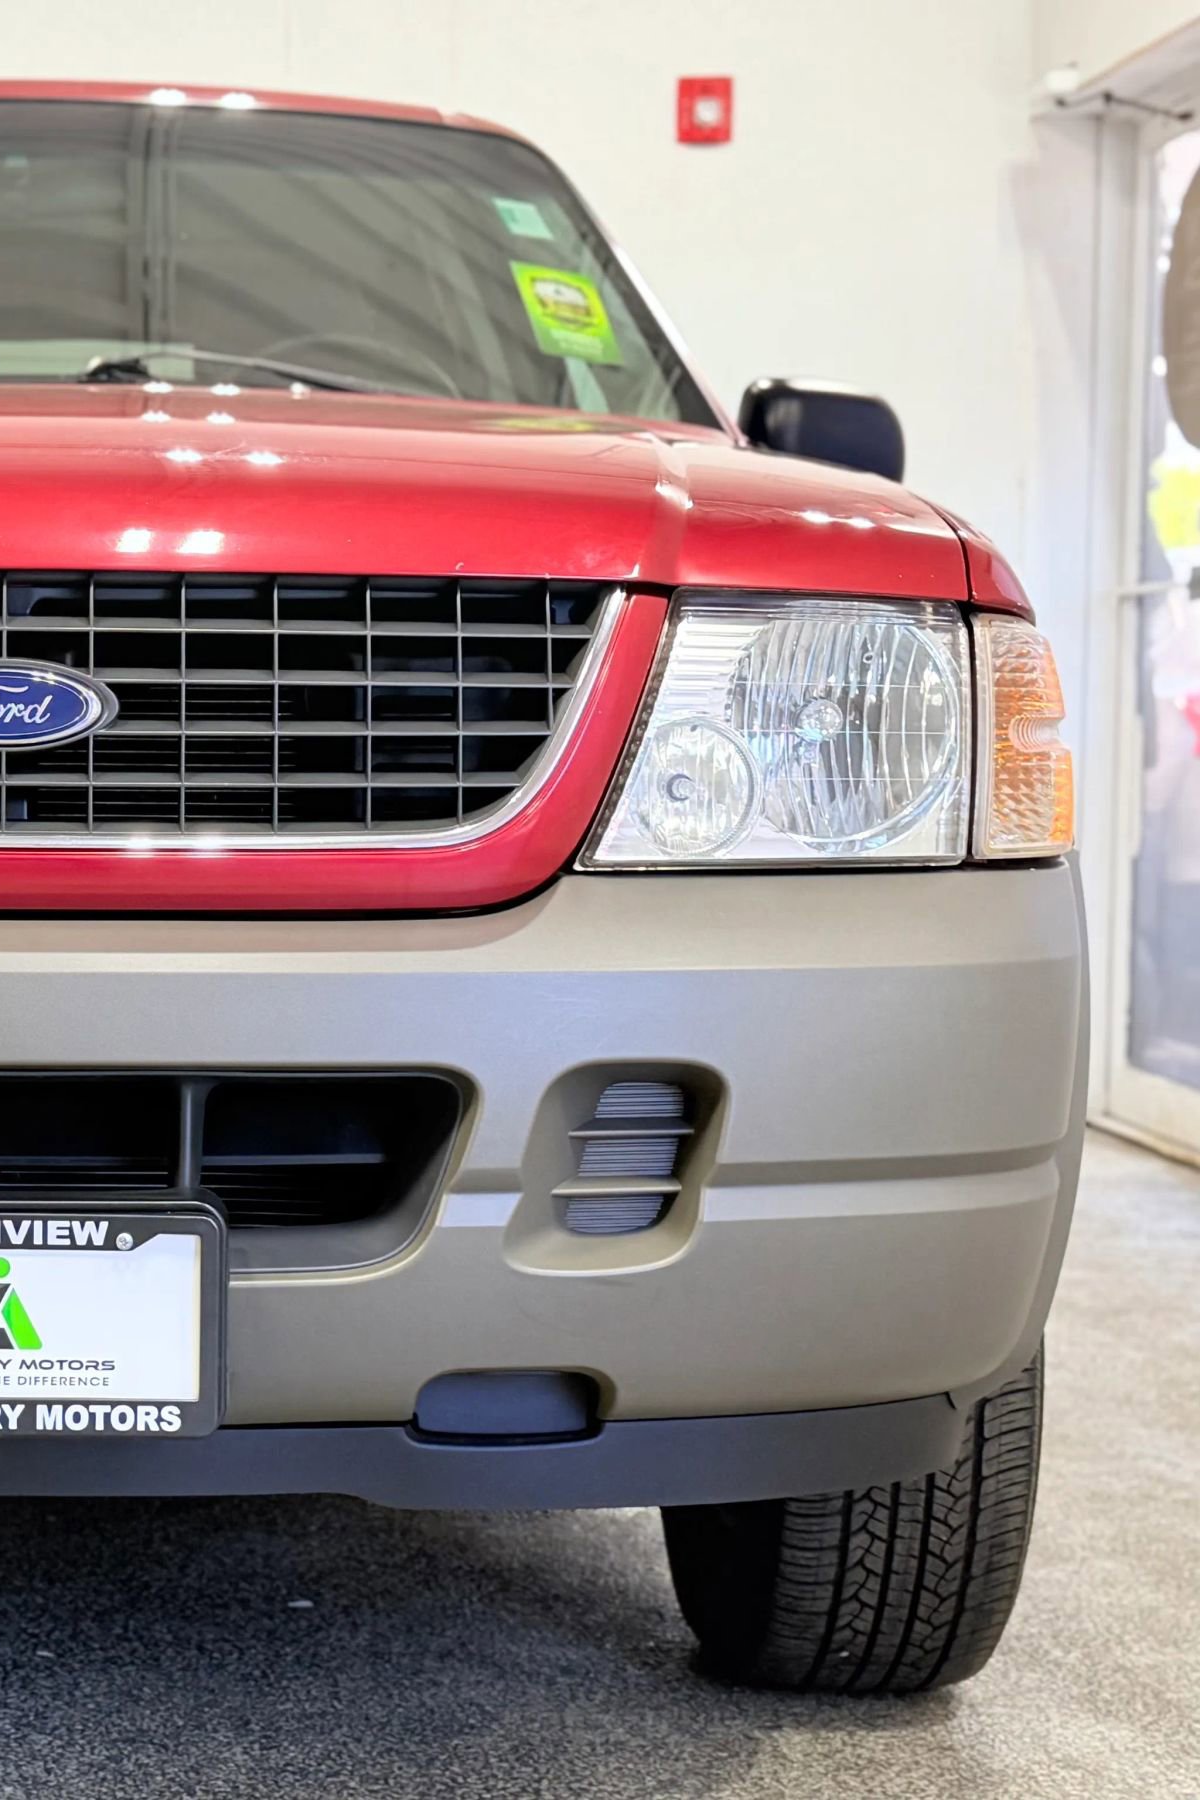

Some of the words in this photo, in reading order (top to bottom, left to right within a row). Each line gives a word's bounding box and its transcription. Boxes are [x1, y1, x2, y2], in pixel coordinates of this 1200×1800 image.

[18, 1358, 117, 1372] MOTORS
[16, 1375, 110, 1388] DIFFERENCE
[35, 1404, 182, 1433] MOTORS
